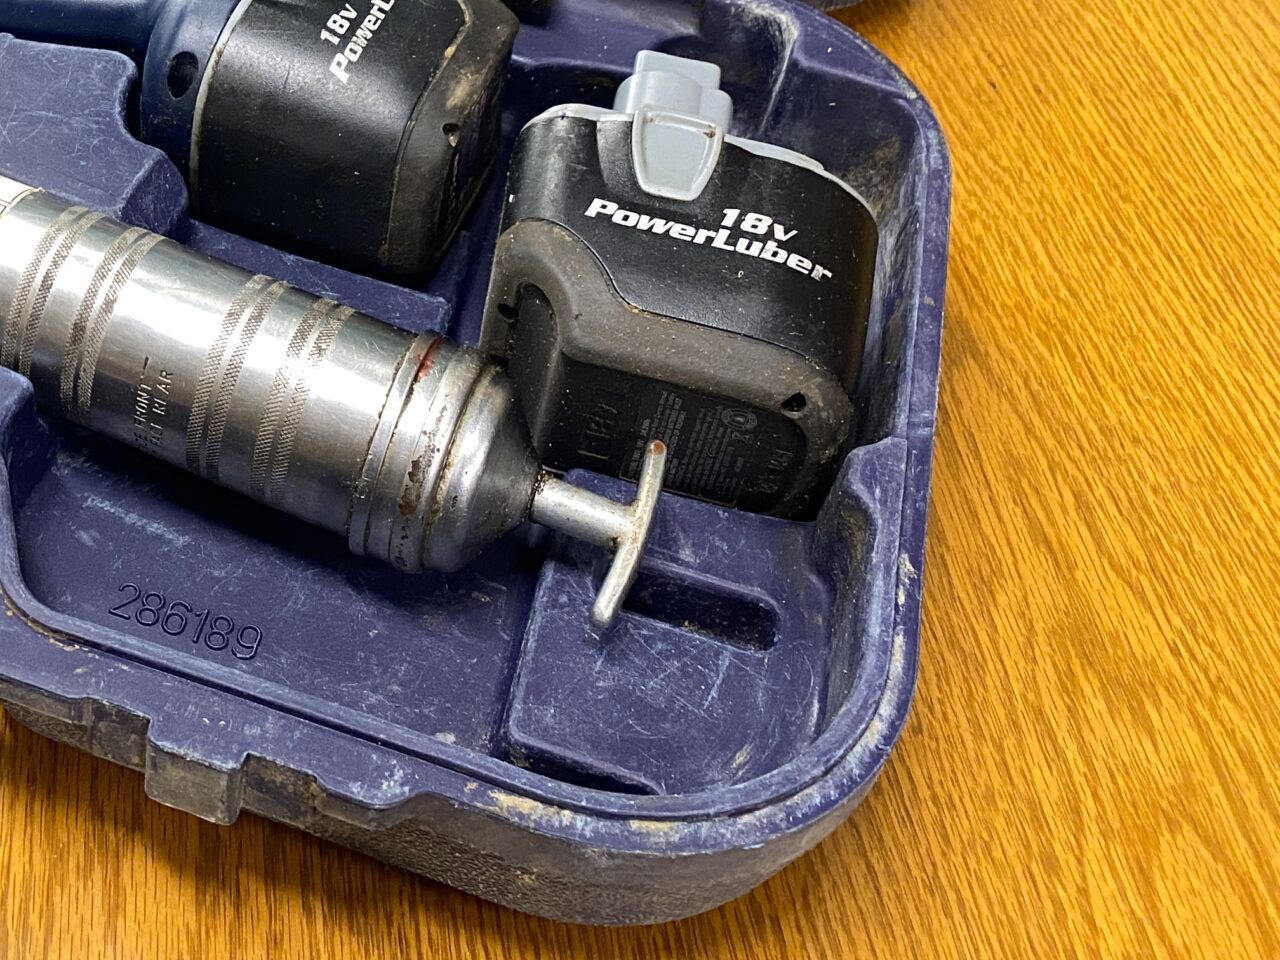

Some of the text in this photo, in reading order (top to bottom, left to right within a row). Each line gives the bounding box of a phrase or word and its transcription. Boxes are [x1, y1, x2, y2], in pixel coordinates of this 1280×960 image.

[320, 3, 358, 46] 18v
[584, 197, 832, 282] PowerLuber
[720, 207, 799, 242] 18v
[108, 582, 263, 660] 286189
